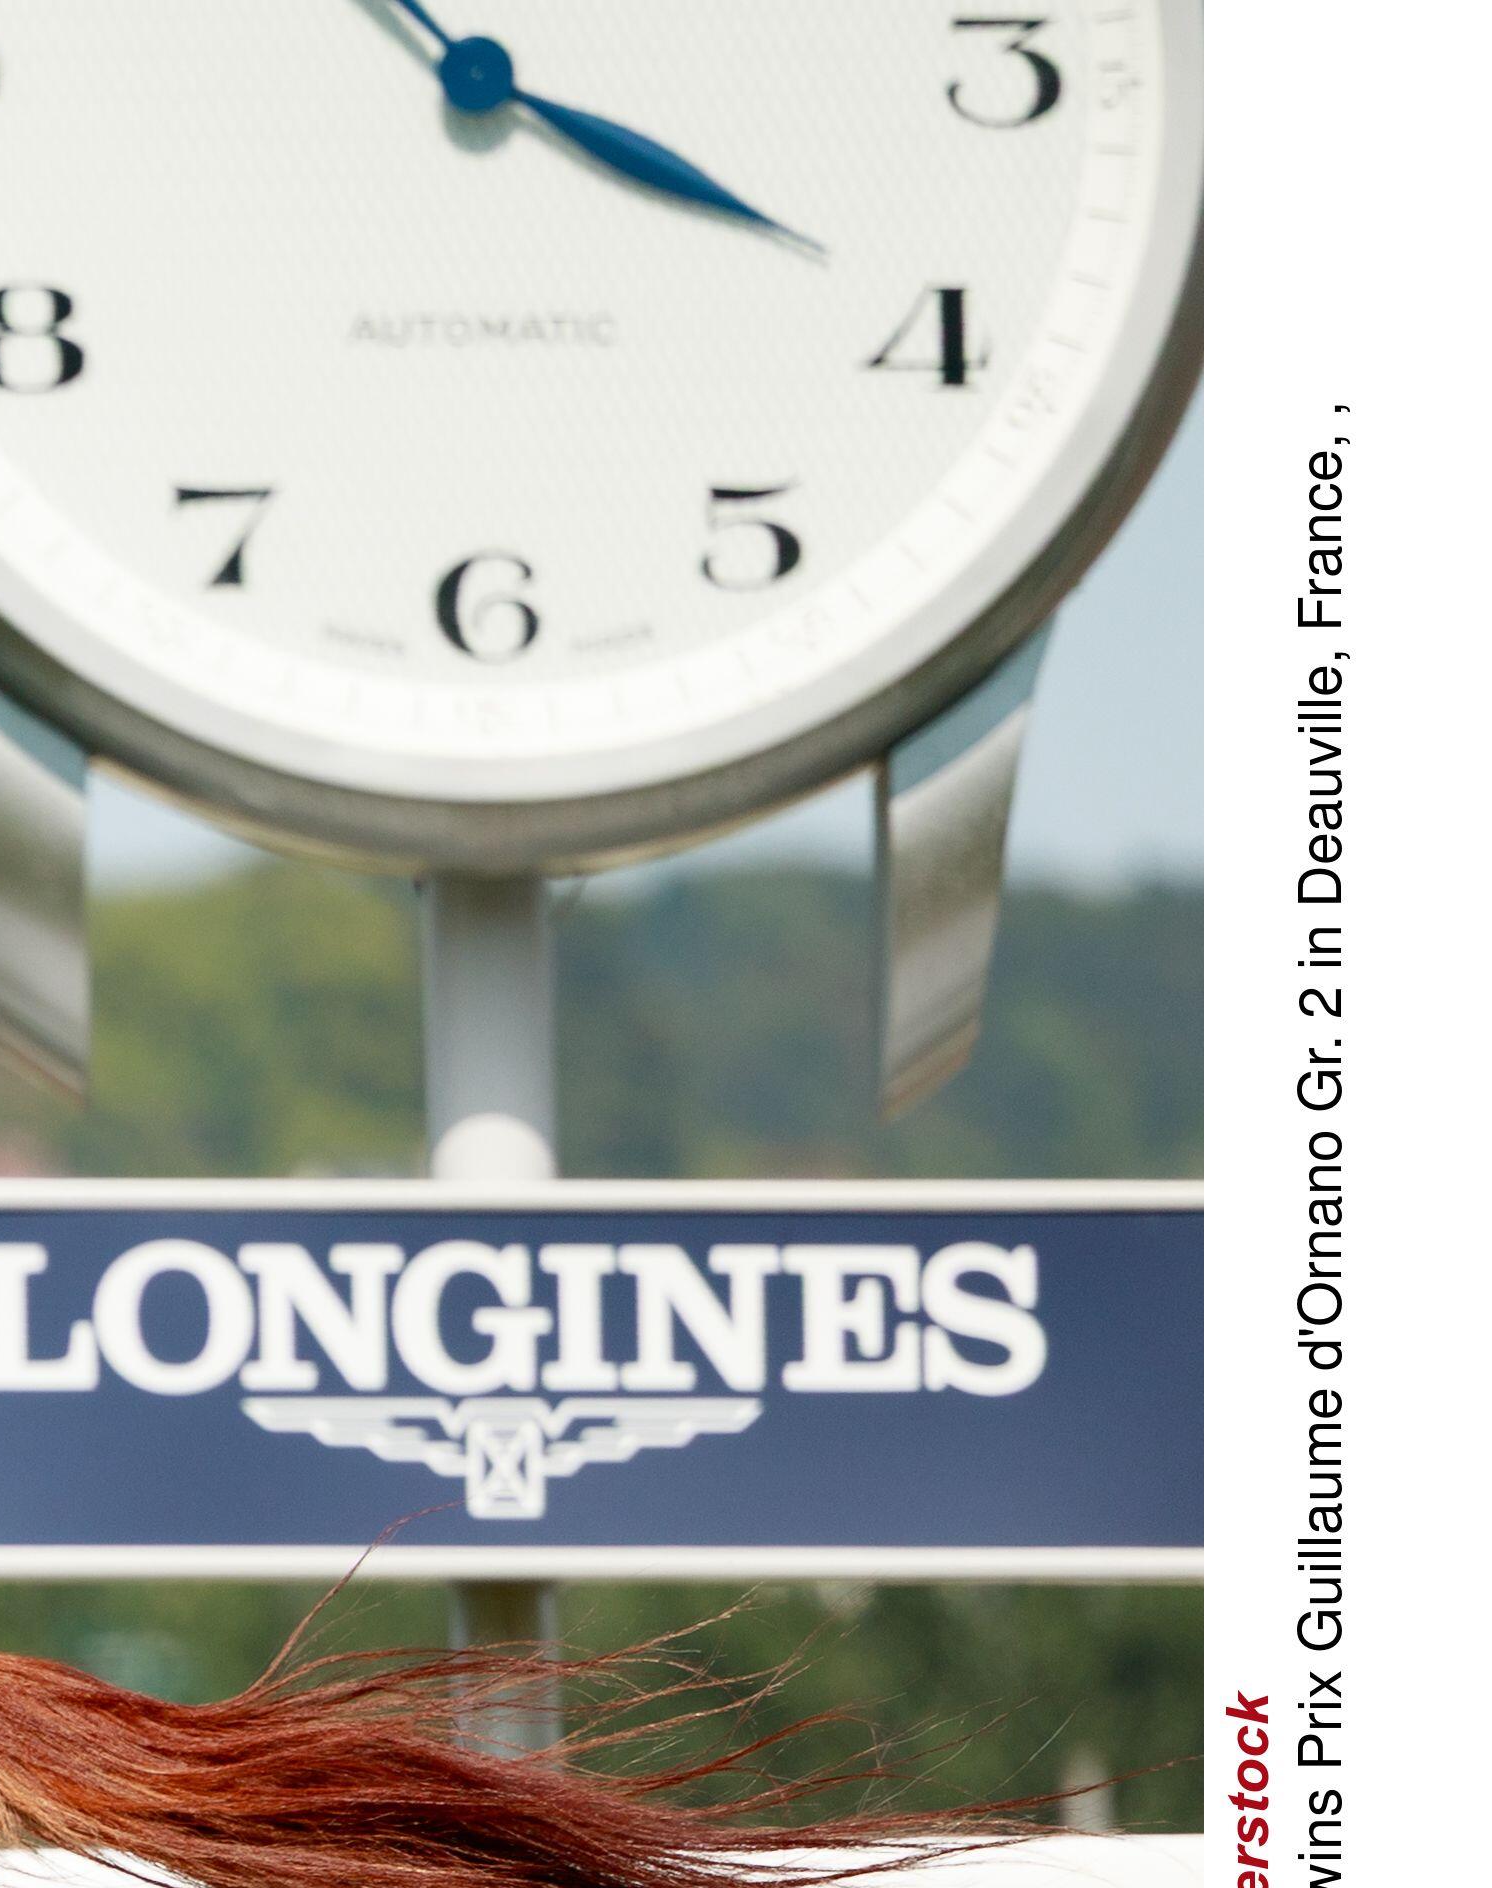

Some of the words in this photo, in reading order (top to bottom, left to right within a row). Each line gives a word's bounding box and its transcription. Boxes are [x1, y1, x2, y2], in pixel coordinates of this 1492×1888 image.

[944, 14, 1066, 130] 3
[348, 314, 620, 348] AUTOMATIC
[864, 284, 989, 393] 4
[173, 485, 276, 590] 7
[700, 482, 803, 591] 5
[431, 551, 542, 663] 6
